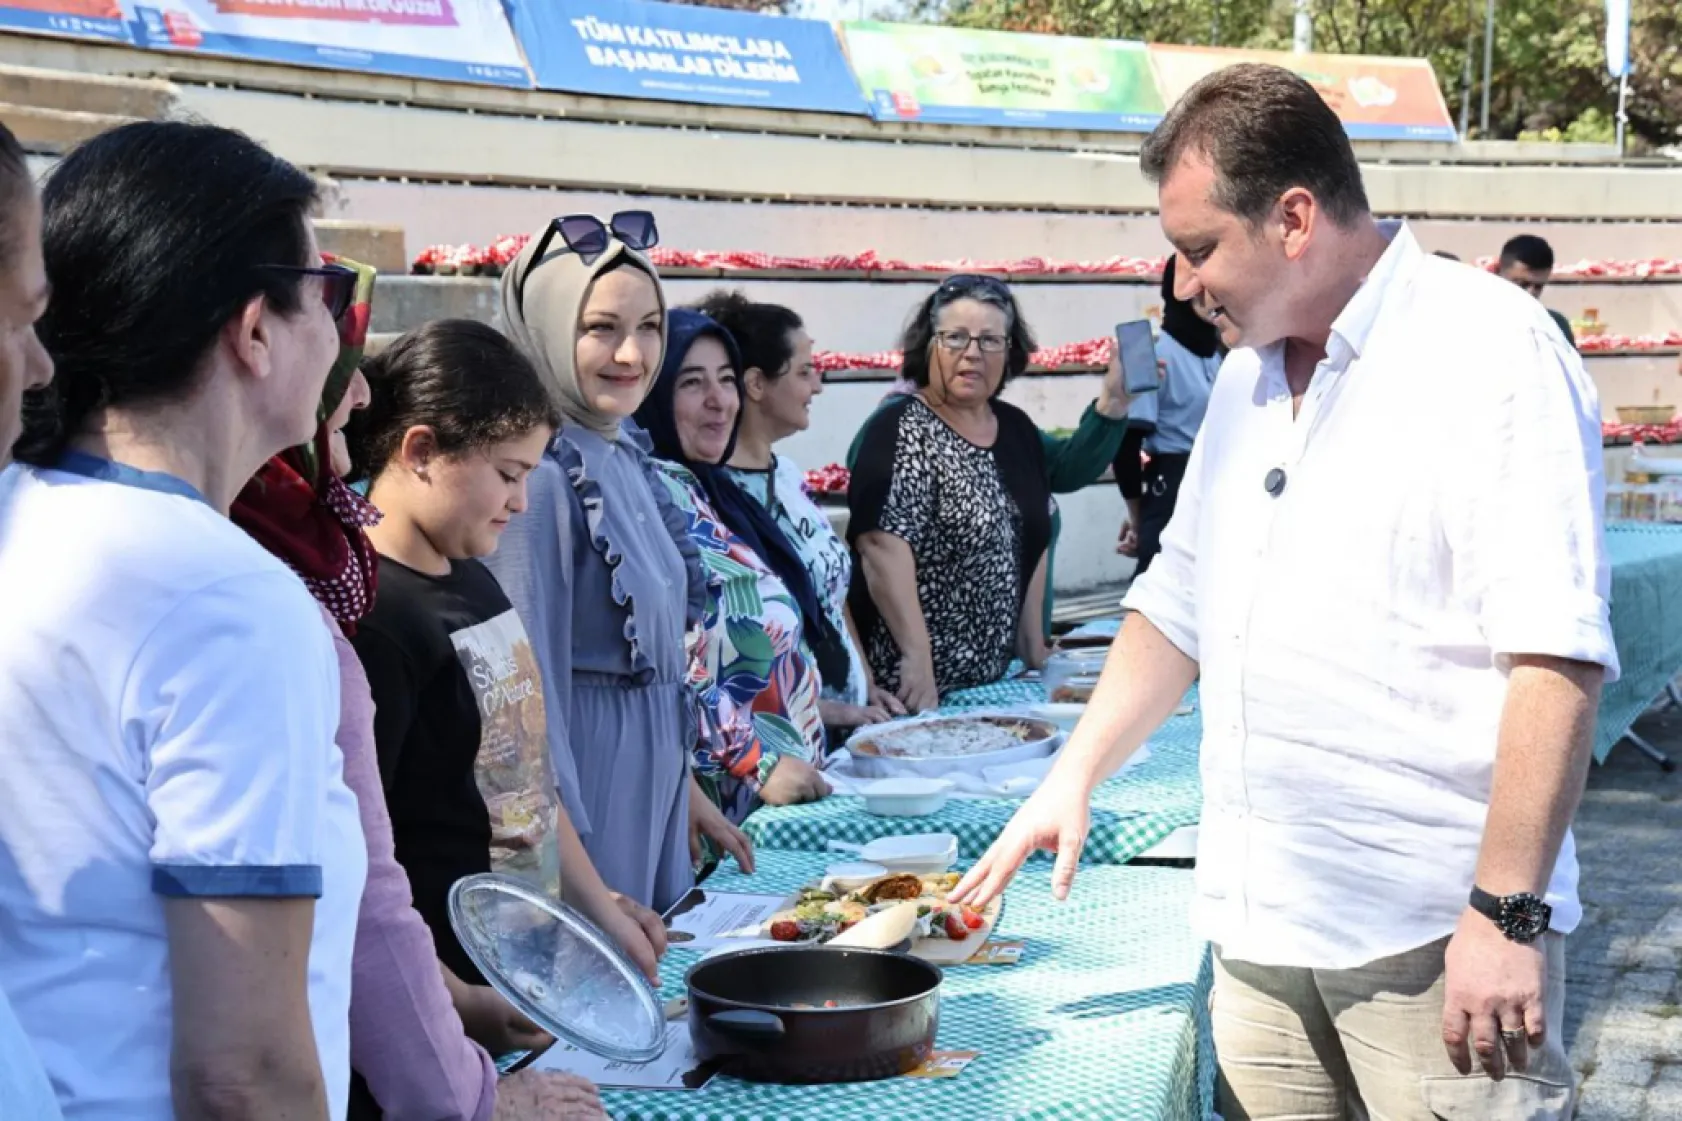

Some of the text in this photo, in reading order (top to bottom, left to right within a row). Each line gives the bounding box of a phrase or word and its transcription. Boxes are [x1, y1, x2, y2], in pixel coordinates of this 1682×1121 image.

[571, 15, 792, 60] TÜM KATILIMCILARA
[585, 46, 800, 83] BAŞARILAR DİLERİM
